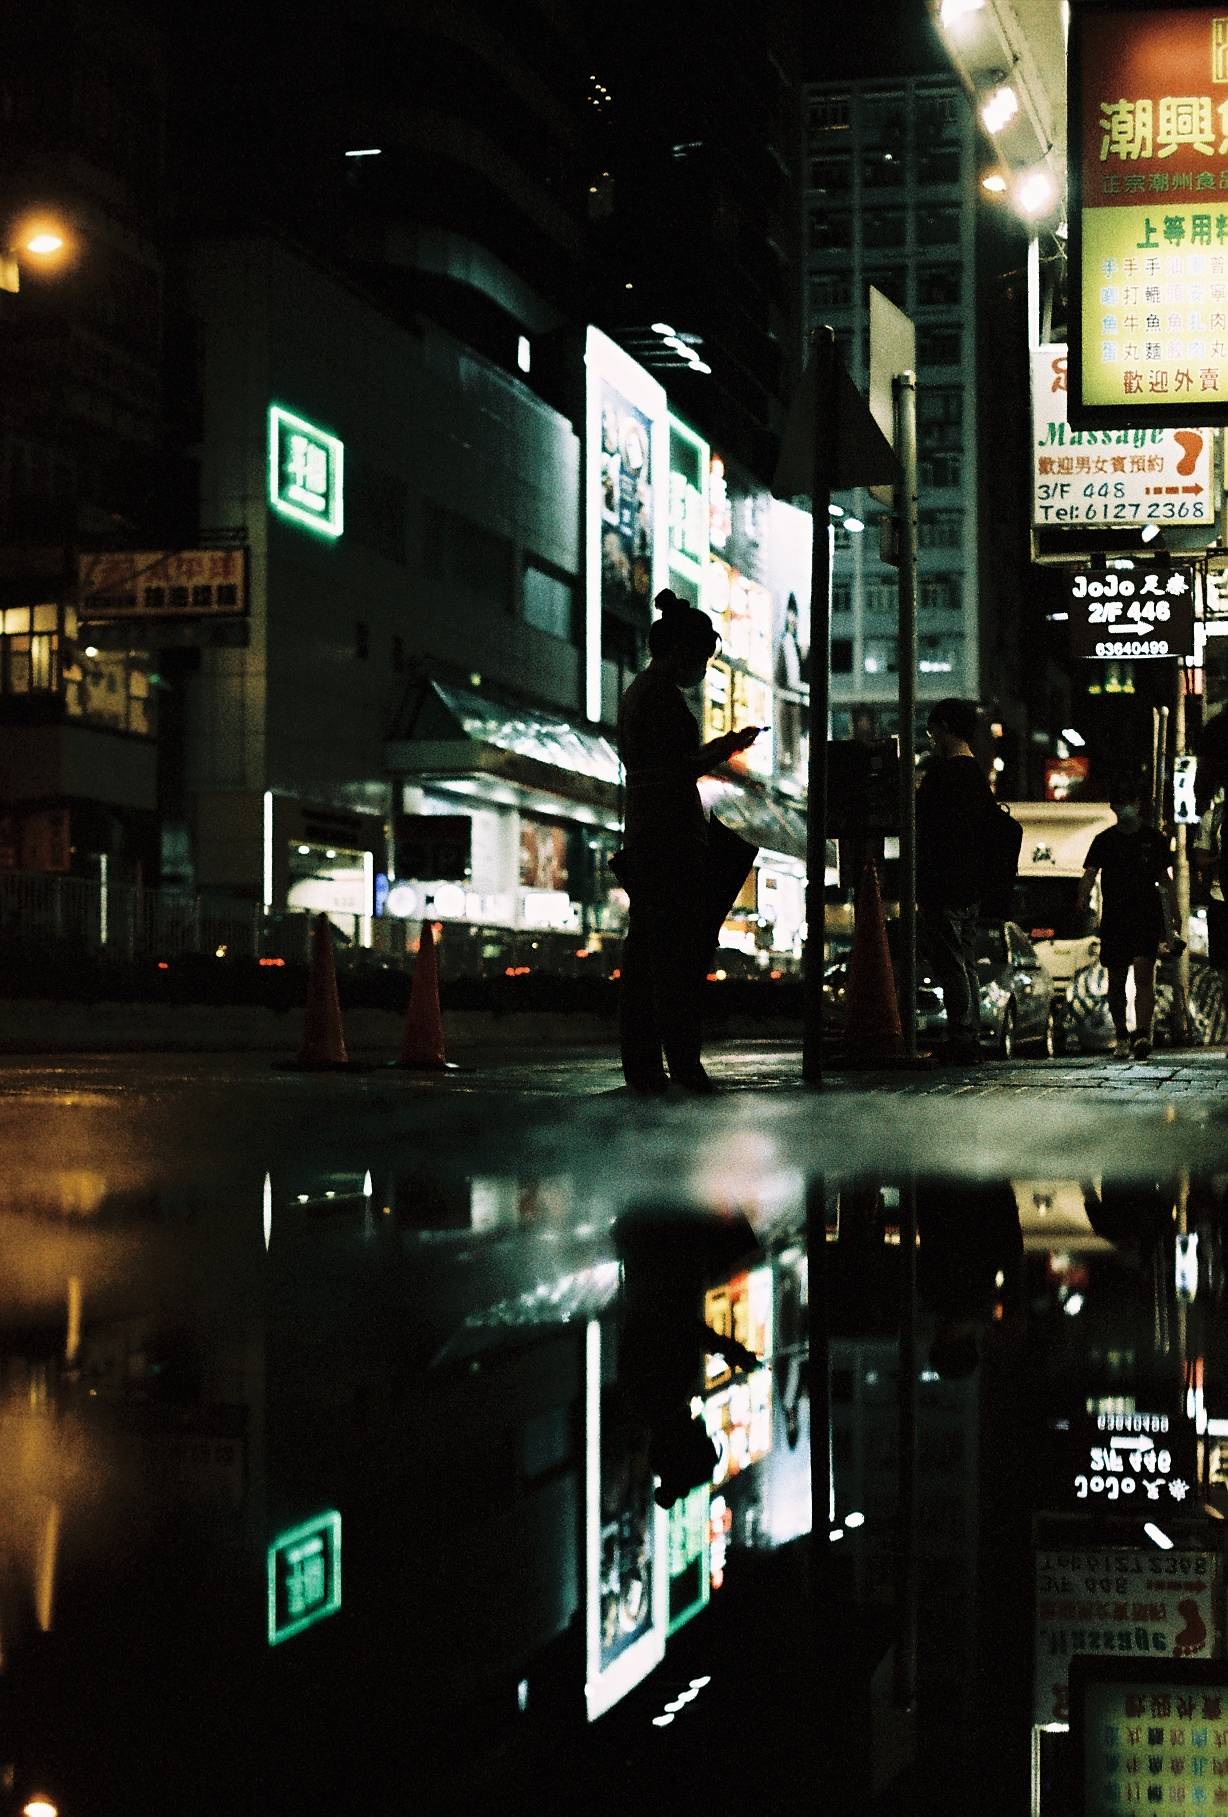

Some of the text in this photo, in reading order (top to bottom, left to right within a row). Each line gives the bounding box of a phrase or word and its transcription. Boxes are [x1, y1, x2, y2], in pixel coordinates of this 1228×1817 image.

[1099, 97, 1228, 161] 潮興
[1123, 256, 1140, 361] 手打牛丸
[1123, 367, 1220, 395] 歡迎外賣
[1038, 455, 1165, 477] 歡迎男女賓預約
[1037, 481, 1126, 500] 3/F 448
[1039, 504, 1080, 521] Tel:
[1072, 573, 1135, 598] JoJo
[1088, 601, 1124, 624] 2/F
